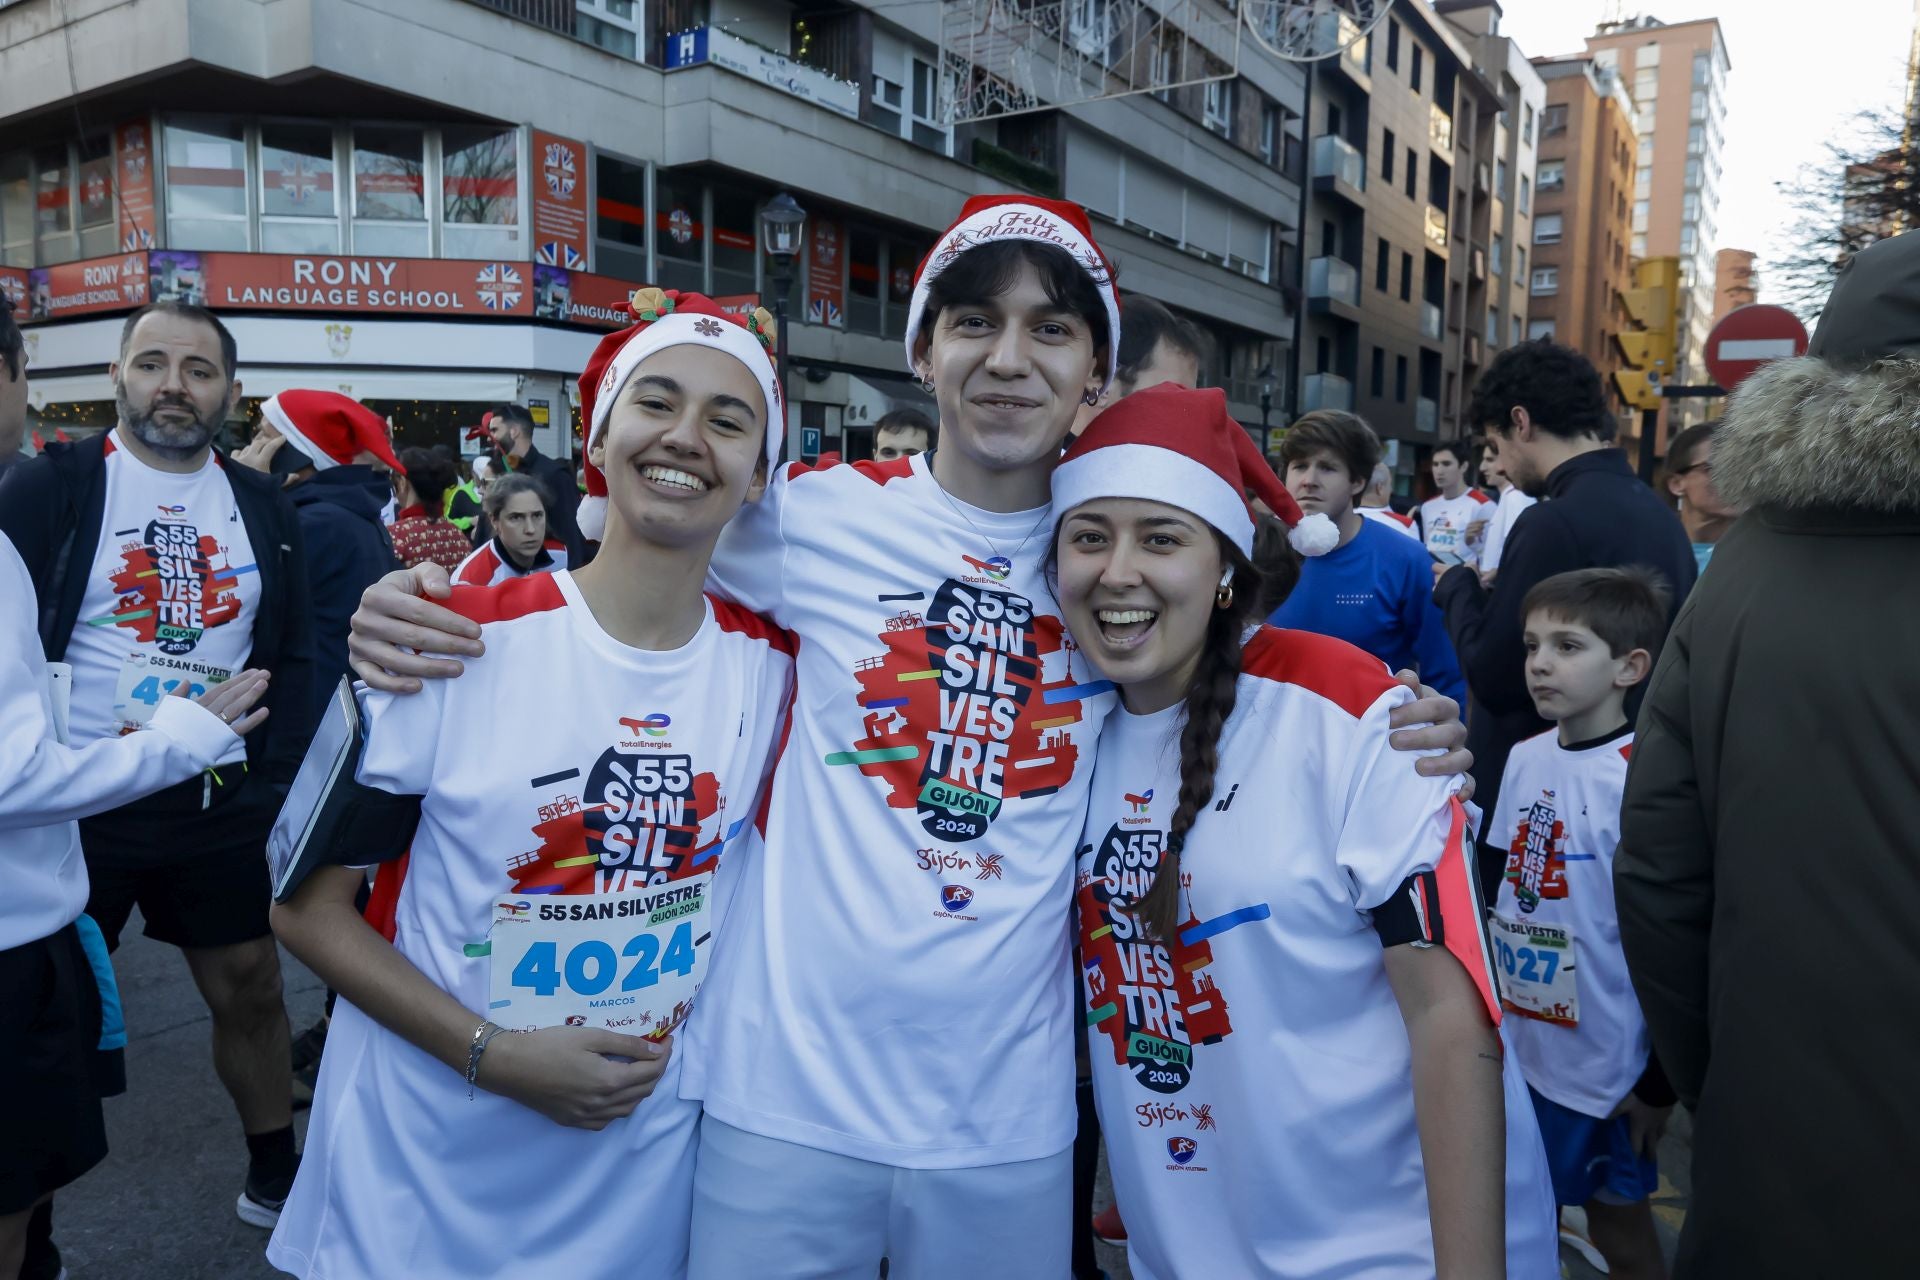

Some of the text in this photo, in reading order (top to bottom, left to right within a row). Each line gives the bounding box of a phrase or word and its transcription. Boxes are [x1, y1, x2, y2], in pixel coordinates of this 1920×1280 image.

[998, 211, 1060, 232] Feliz
[973, 222, 1078, 251] Navidad
[84, 265, 119, 287] RONY
[294, 259, 397, 286] RONY
[48, 289, 120, 309] LANGUAGE SCHOOL
[227, 287, 464, 308] LANGUAGE SCHOOL
[564, 303, 628, 323] LANGUAGE
[808, 431, 815, 446] P
[154, 534, 198, 560] SAN
[168, 525, 197, 544] 55
[158, 555, 200, 579] SIL
[161, 578, 203, 600] VES
[157, 600, 204, 629] TRE
[977, 590, 1030, 624] 55
[945, 605, 1024, 657] SAN
[167, 643, 190, 651] 2024
[150, 656, 165, 666] 55
[166, 659, 190, 671] SAN
[942, 644, 1016, 696] SIL
[939, 689, 1015, 740] VES
[620, 741, 672, 749] TotalEnergies
[635, 758, 688, 792] 55
[927, 730, 1010, 799] TRE
[603, 781, 685, 827] SAN
[930, 786, 990, 815] GIJÓN
[936, 819, 976, 835] 2024
[1529, 814, 1552, 840] SAN
[1538, 807, 1556, 826] 55
[600, 824, 674, 868] SIL
[1125, 835, 1159, 867] 55
[1526, 832, 1547, 855] SIL
[917, 848, 971, 874] gijón
[1524, 850, 1546, 874] VES
[1521, 866, 1543, 897] TRE
[539, 883, 702, 921] 55 SAN SILVESTRE
[651, 901, 700, 923] GIJÓN 2024
[1511, 924, 1566, 940] SILVESTRE
[512, 921, 695, 996] 4024
[1116, 943, 1174, 987] VES
[589, 997, 635, 1008] MARCOS
[1118, 985, 1190, 1046] TRE
[1135, 1039, 1184, 1063] GIJÓN
[1149, 1071, 1182, 1085] 2024
[1136, 1102, 1189, 1128] gijón
